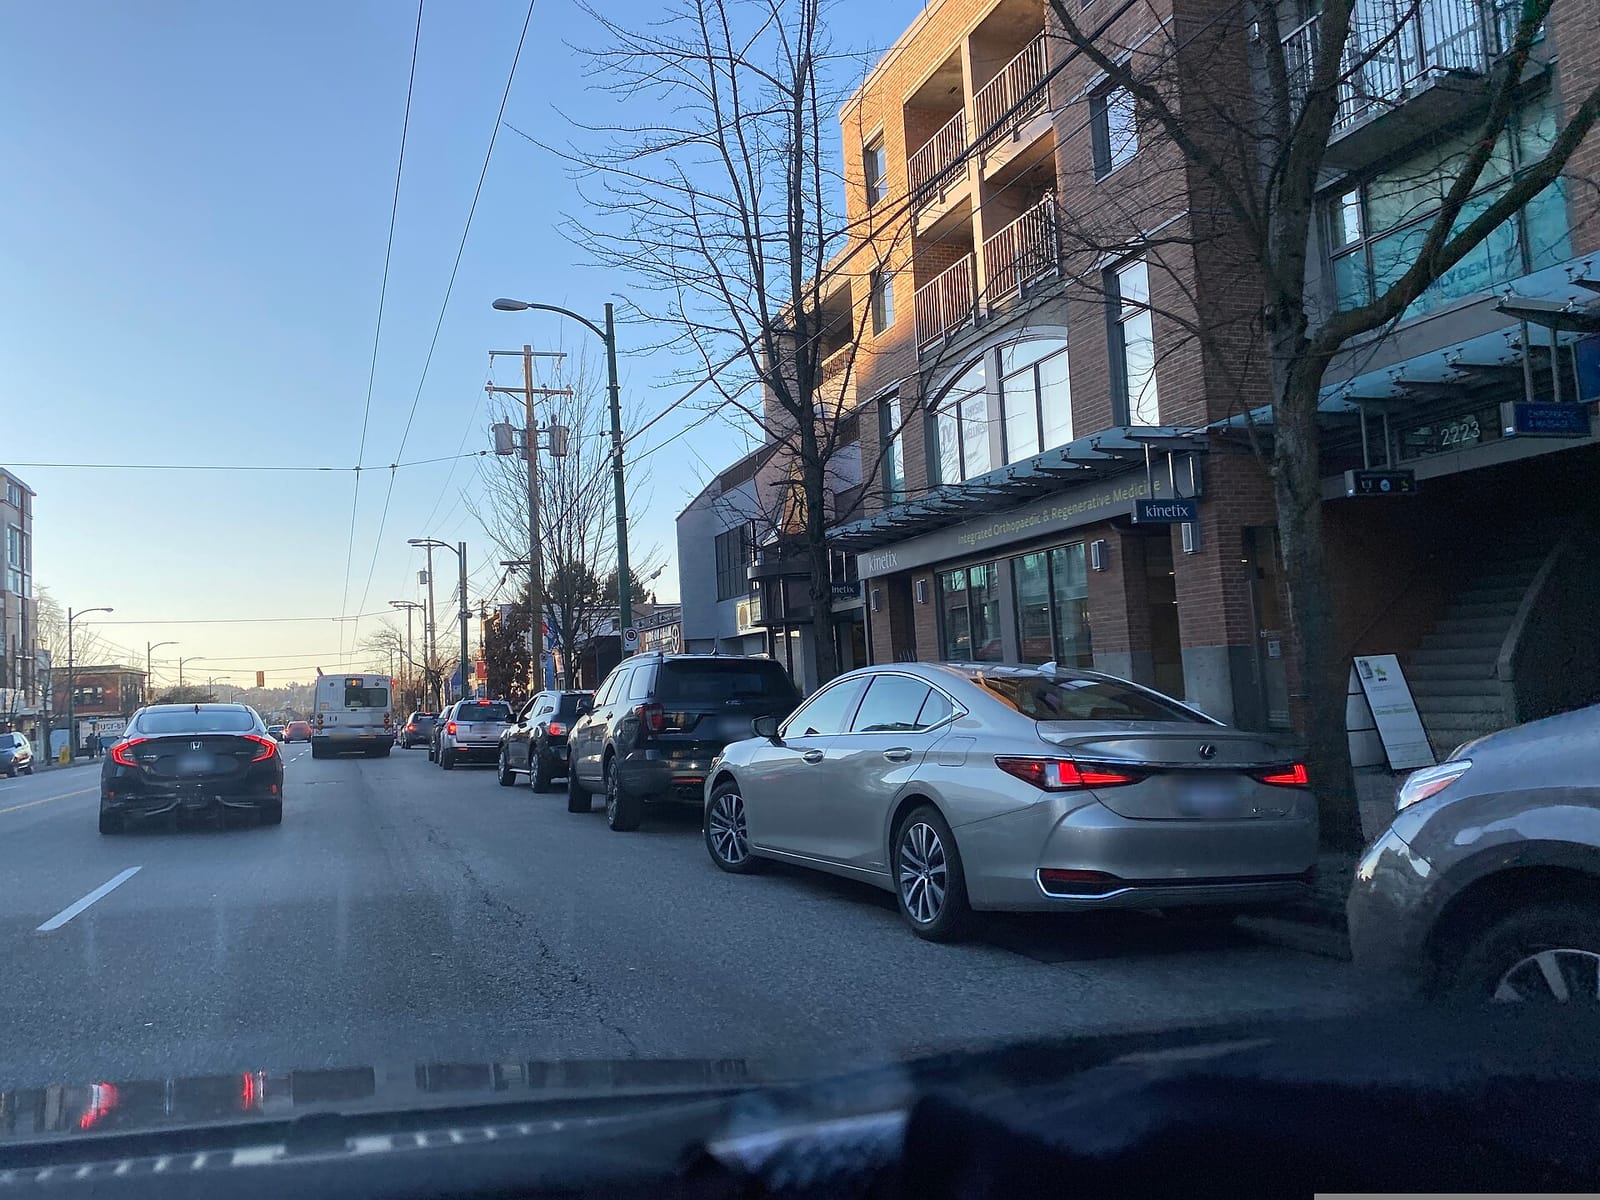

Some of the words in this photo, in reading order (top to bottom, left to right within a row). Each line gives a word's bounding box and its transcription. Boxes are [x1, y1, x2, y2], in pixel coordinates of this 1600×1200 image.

[1441, 421, 1480, 445] 2223
[959, 526, 993, 545] Integrated
[993, 514, 1041, 535] Orthopaedic
[1043, 511, 1050, 521] &
[1051, 496, 1110, 520] Regenerative
[1145, 504, 1188, 517] kinetix
[869, 550, 898, 573] kinetix
[832, 585, 855, 594] inetix
